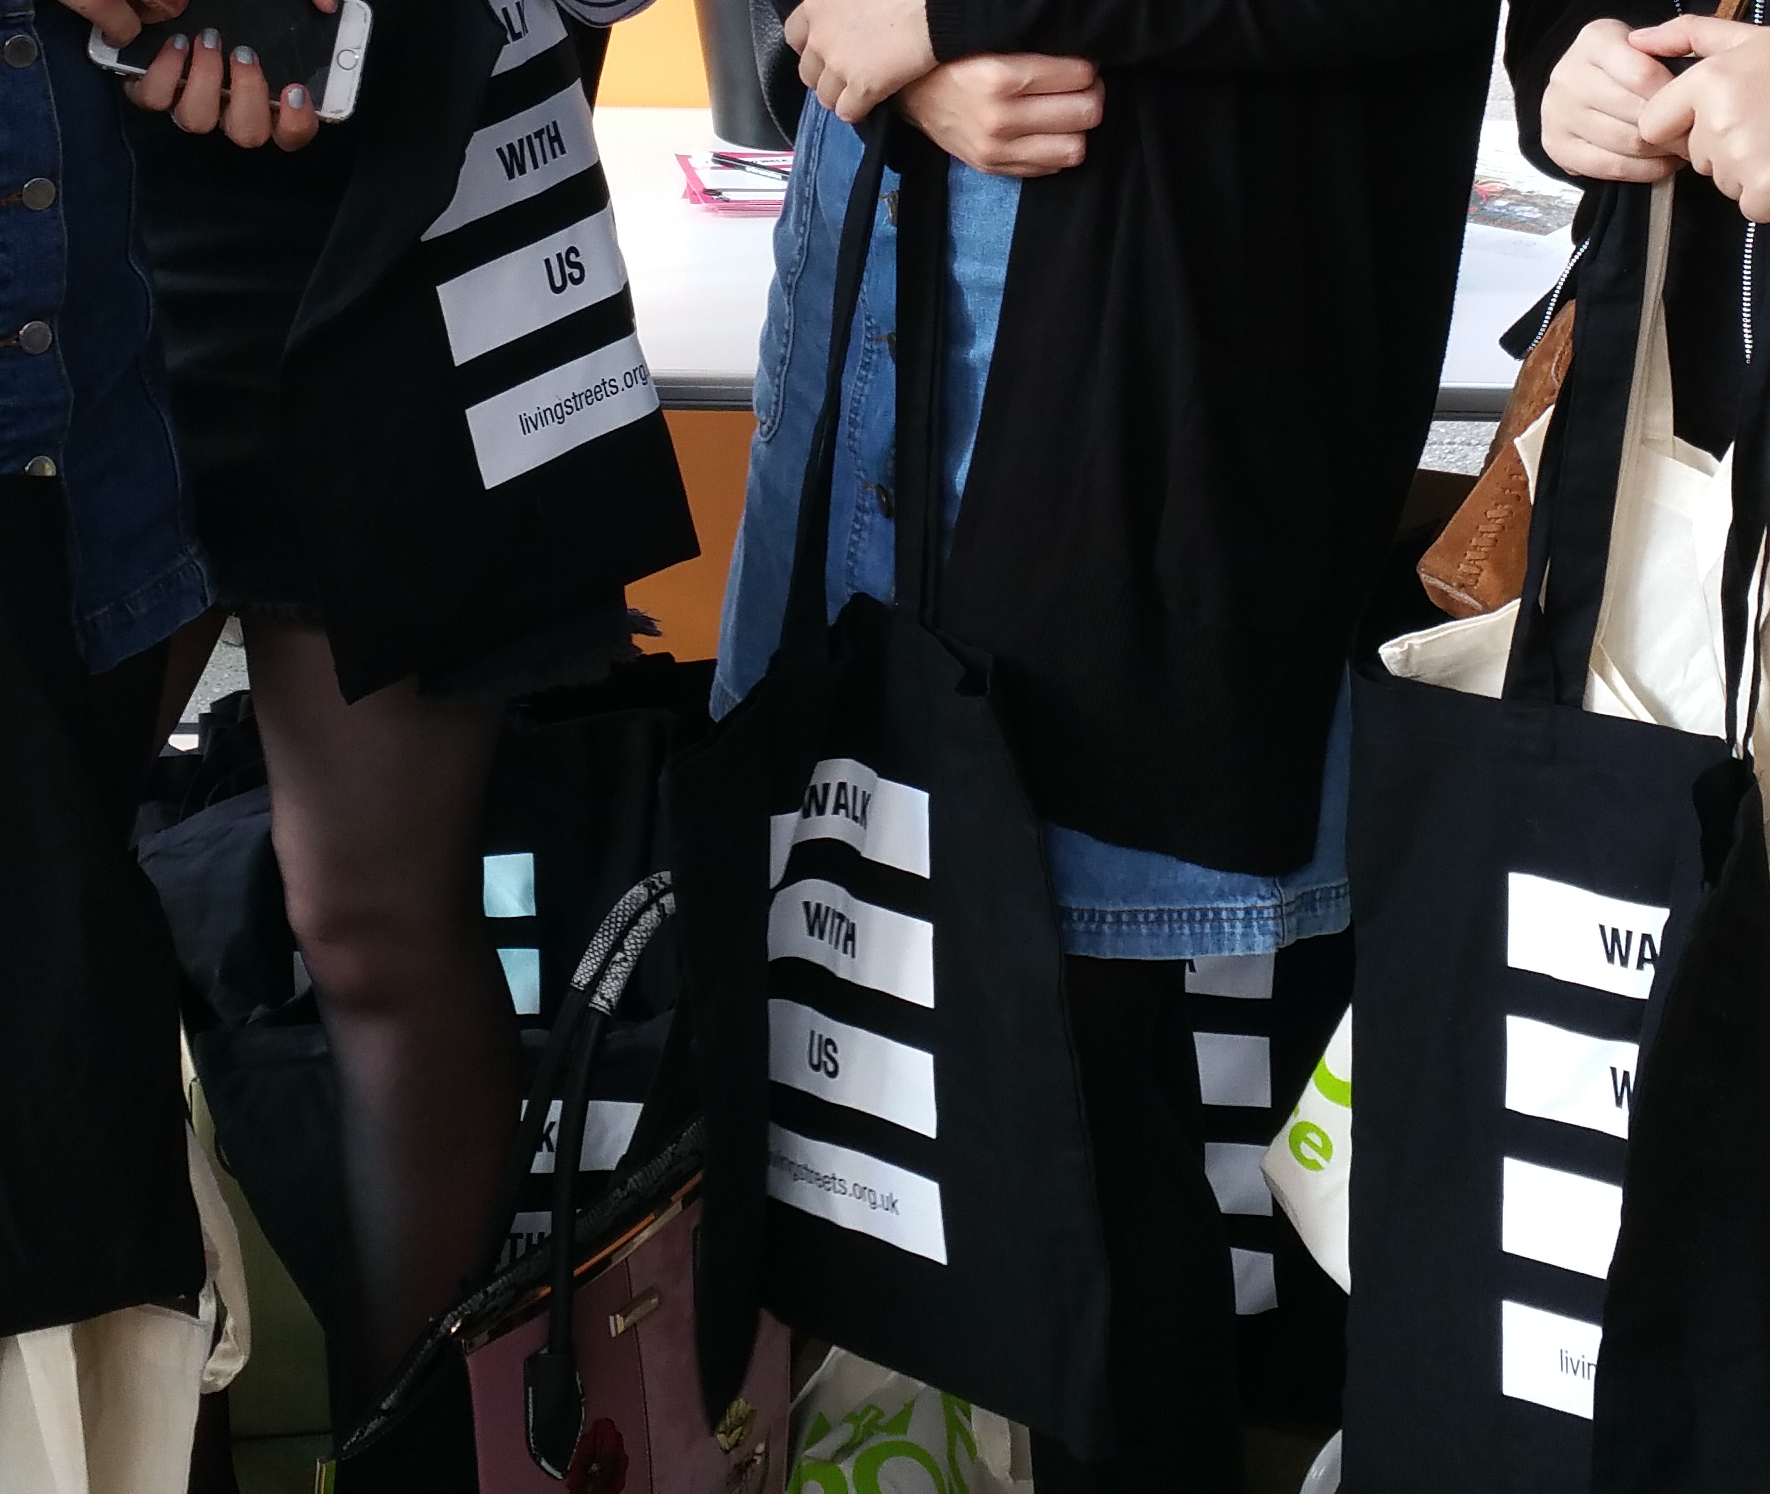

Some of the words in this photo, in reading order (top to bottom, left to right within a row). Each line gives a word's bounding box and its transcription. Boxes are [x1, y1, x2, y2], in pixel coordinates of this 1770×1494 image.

[495, 119, 567, 181] WITH
[543, 245, 586, 296] US
[518, 364, 650, 436] livingstreets.org
[802, 781, 872, 831] WALK
[802, 900, 857, 959] WITH
[1598, 923, 1660, 972] WA
[807, 1029, 841, 1079] US
